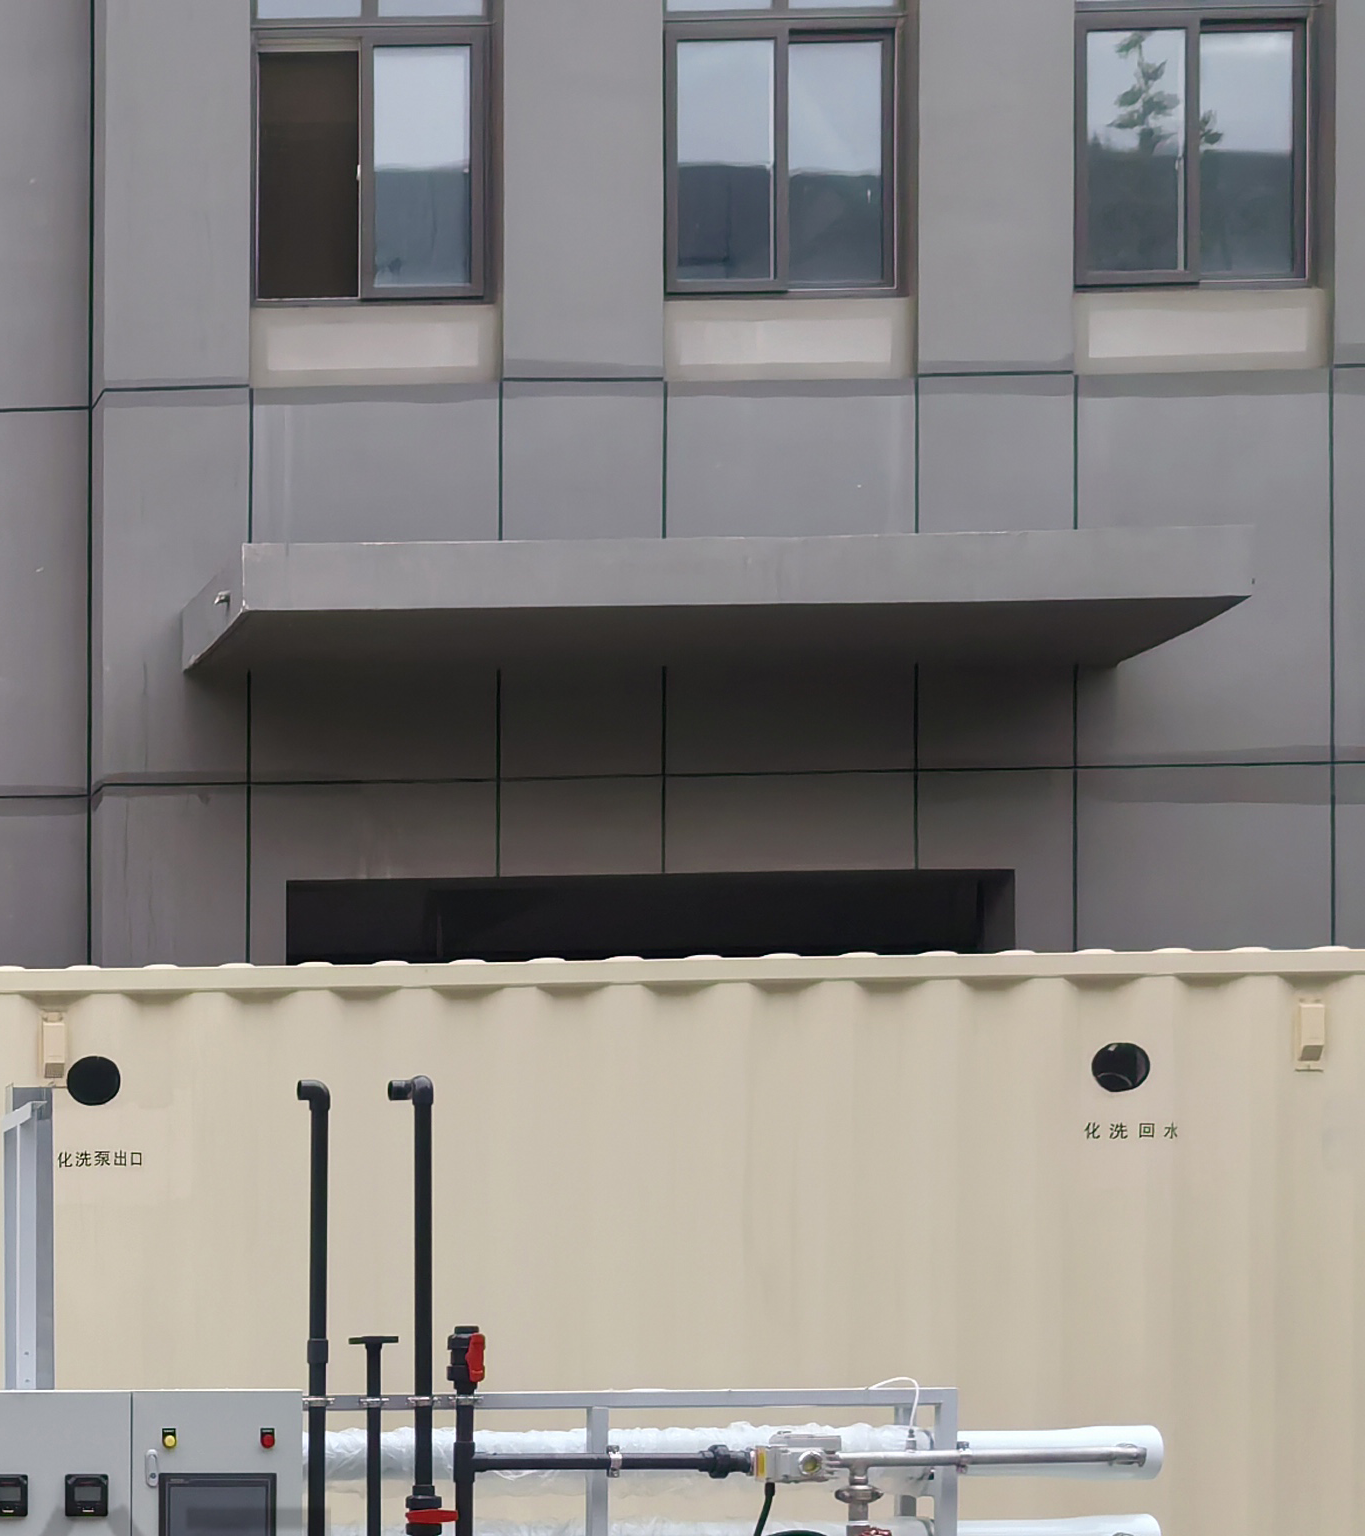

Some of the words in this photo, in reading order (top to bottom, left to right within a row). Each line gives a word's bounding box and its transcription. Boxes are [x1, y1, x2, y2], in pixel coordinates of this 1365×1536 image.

[1084, 1122, 1178, 1139] 化洗回水
[57, 1150, 143, 1168] 化洗泵出口
